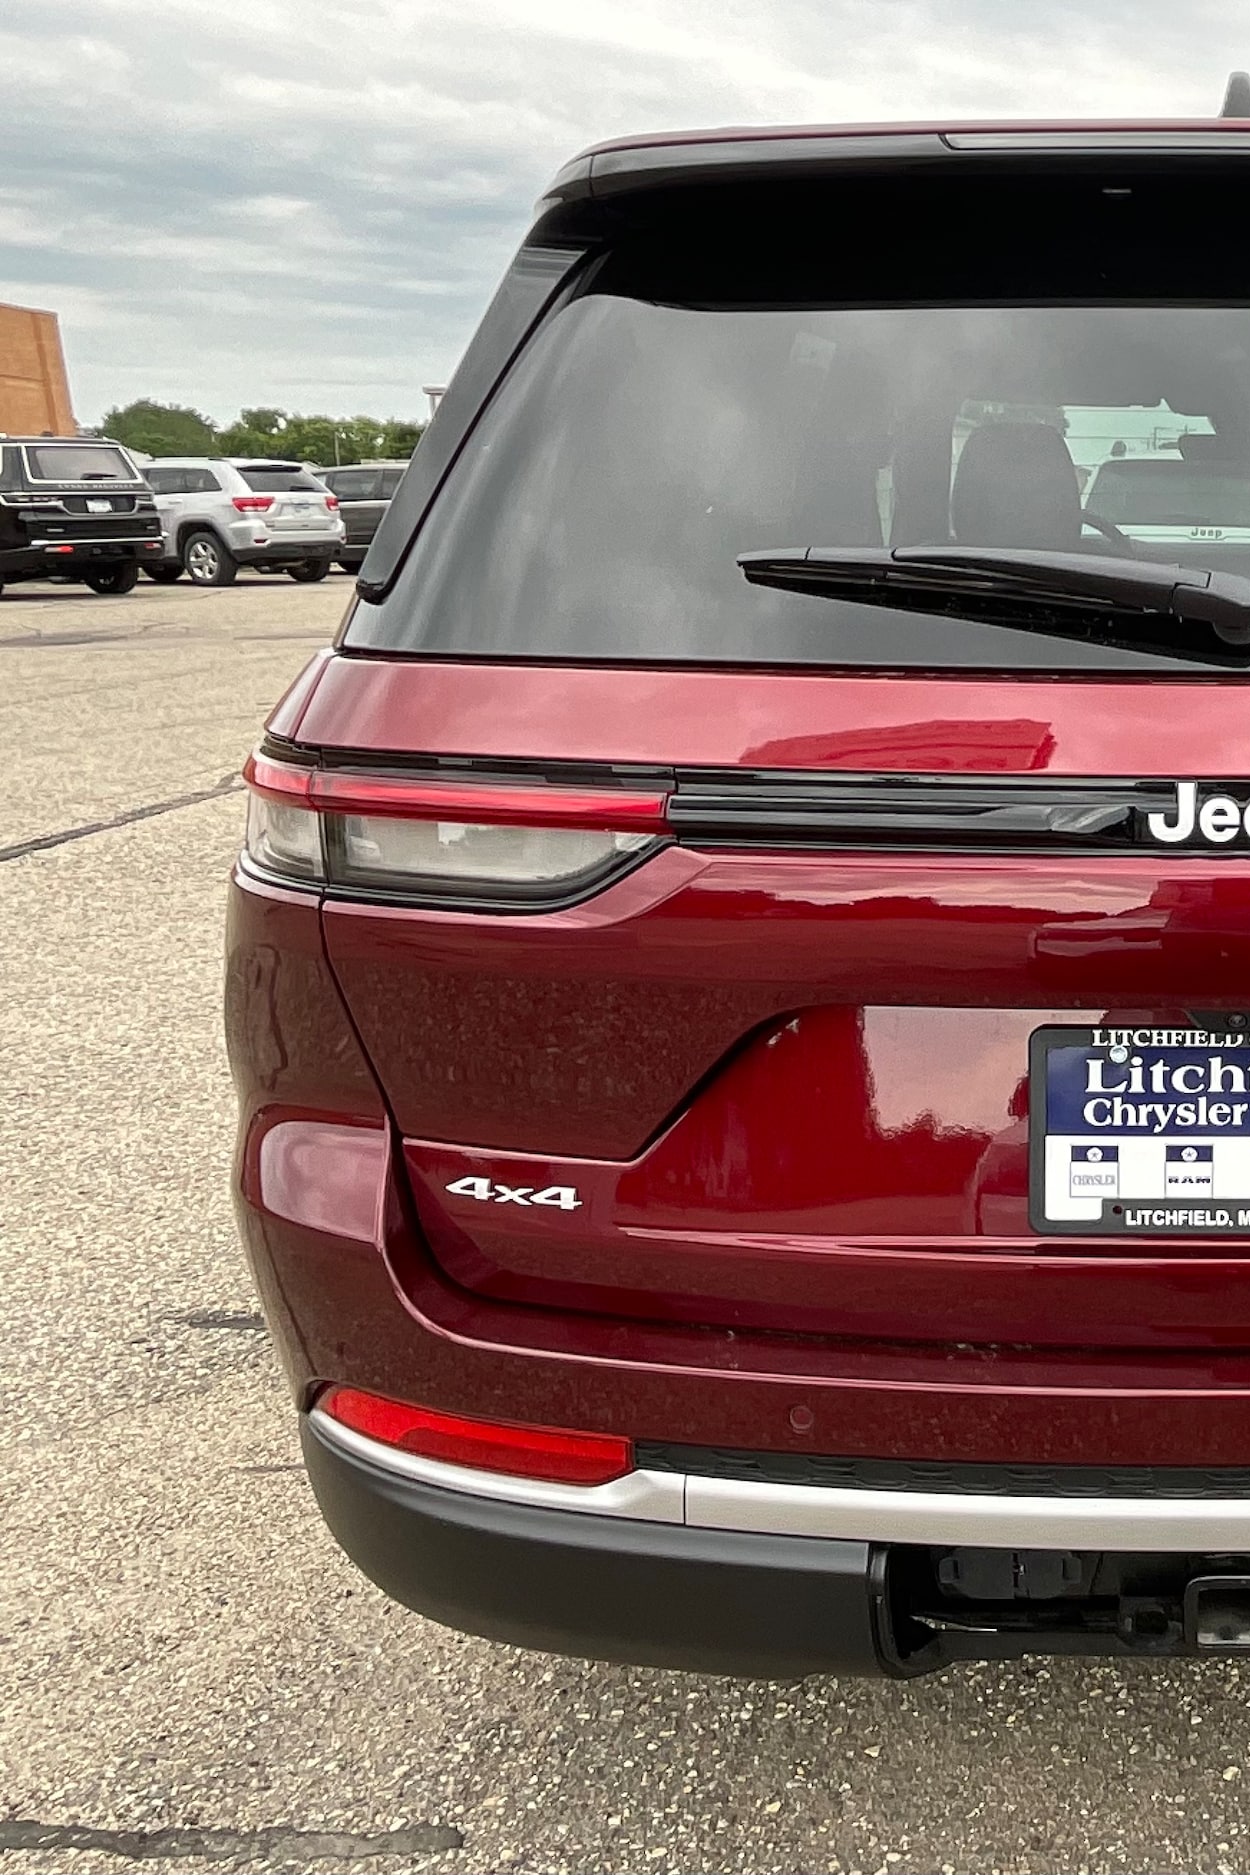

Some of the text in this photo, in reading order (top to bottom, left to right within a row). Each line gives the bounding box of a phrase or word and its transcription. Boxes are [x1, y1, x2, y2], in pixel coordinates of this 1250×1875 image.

[1092, 1029, 1241, 1047] LITCHFIELD
[1083, 1096, 1249, 1133] Chrysler
[445, 1176, 583, 1211] 4x4
[1125, 1209, 1235, 1227] LITCHFIELD,
